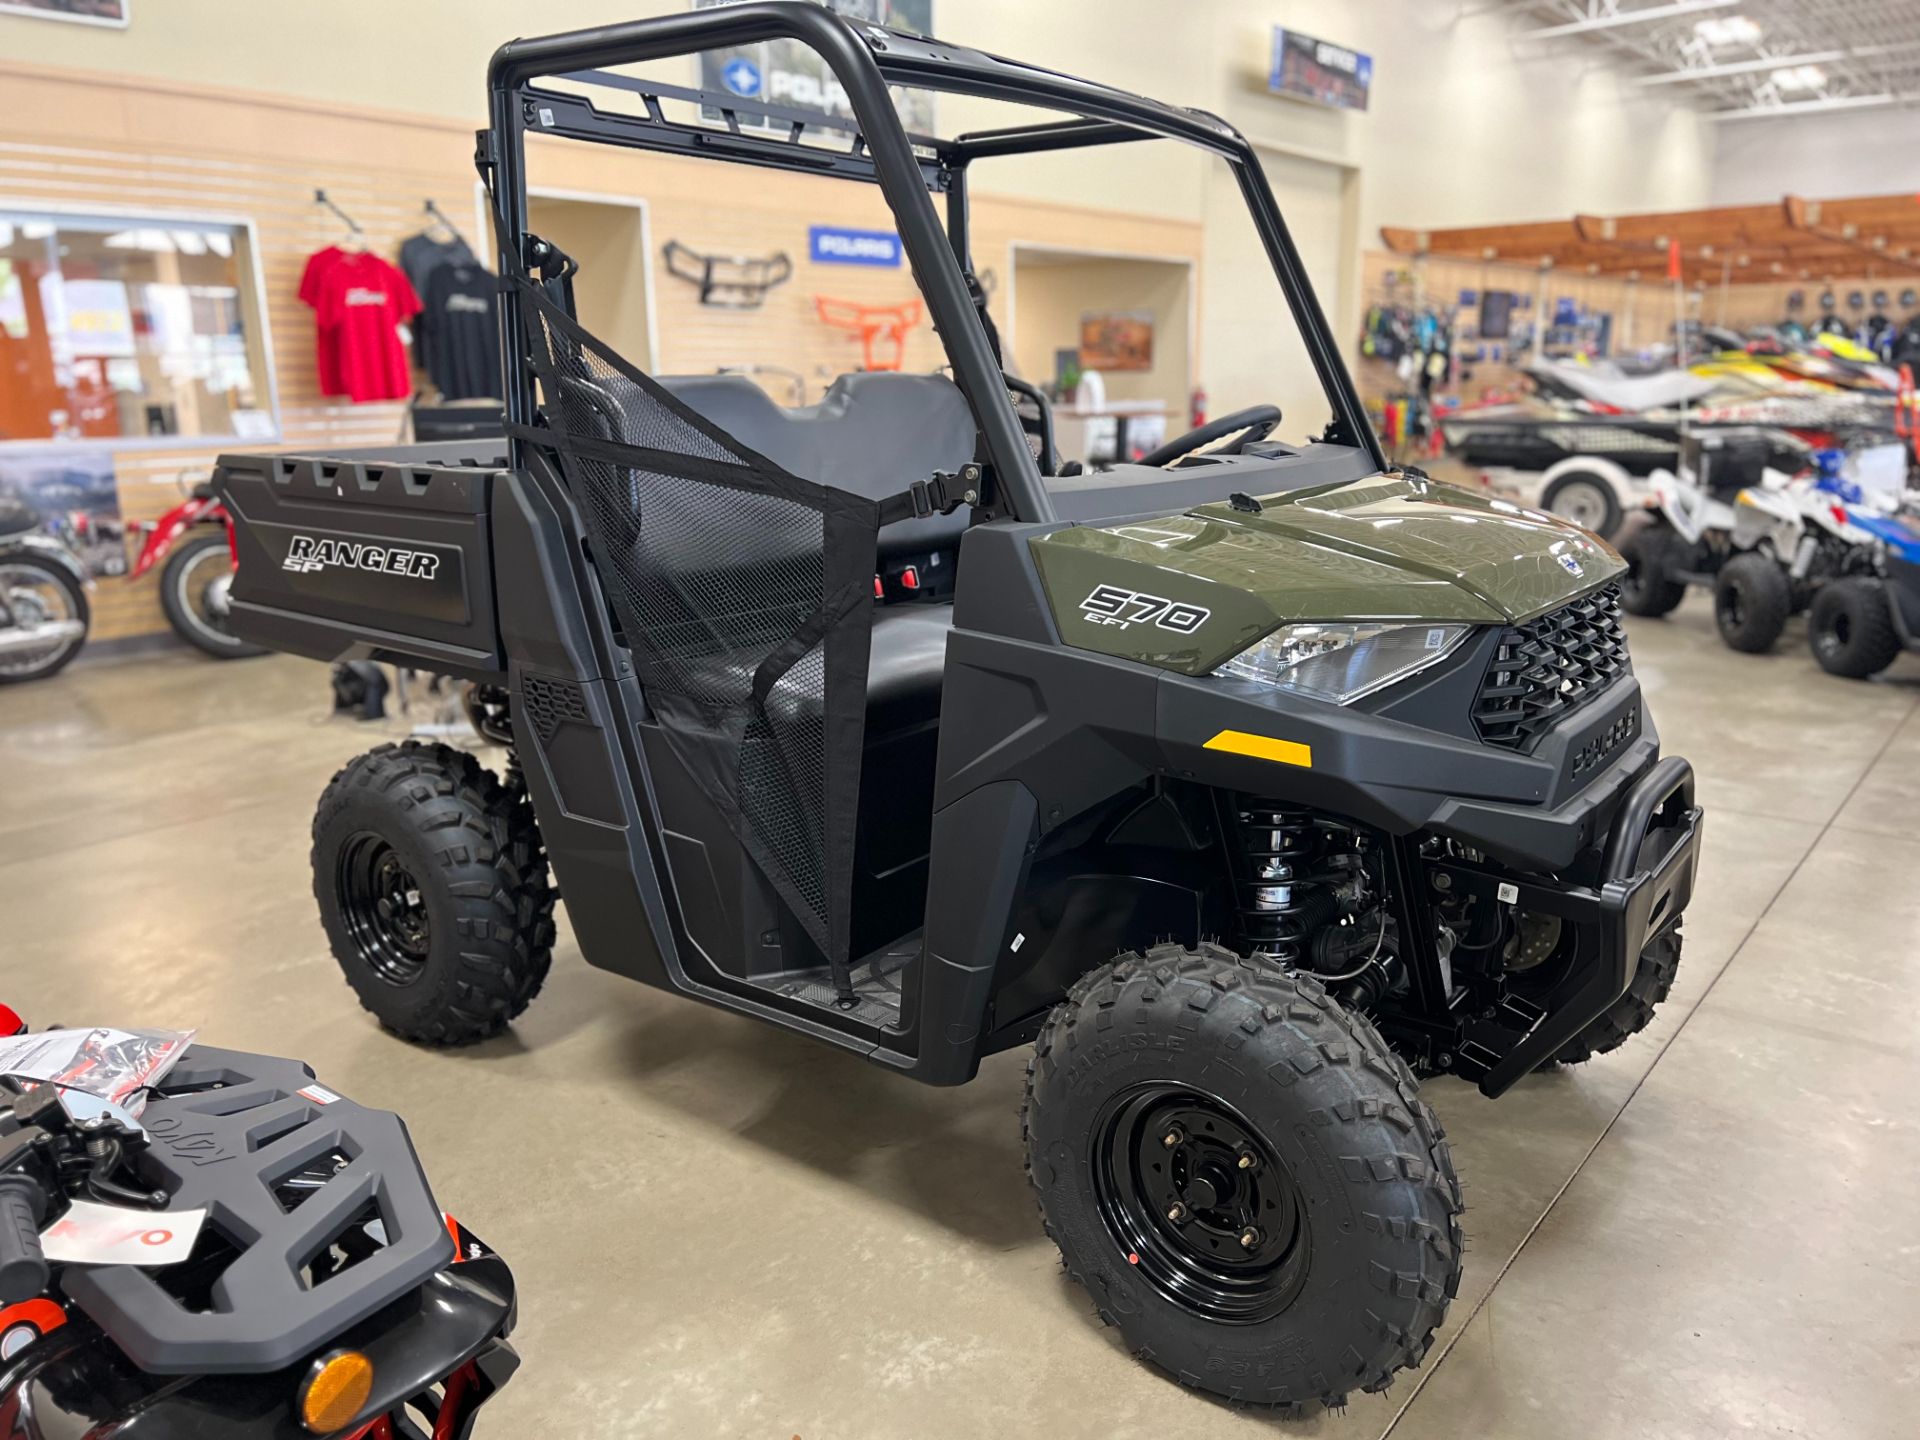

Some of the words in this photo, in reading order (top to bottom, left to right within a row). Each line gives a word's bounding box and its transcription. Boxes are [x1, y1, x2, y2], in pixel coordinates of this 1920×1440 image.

[818, 234, 895, 259] POLARIS
[282, 557, 324, 573] SP
[288, 535, 440, 580] RANGER
[1079, 584, 1211, 634] 570
[1083, 612, 1130, 630] EFI
[1571, 706, 1637, 782] POLARIS
